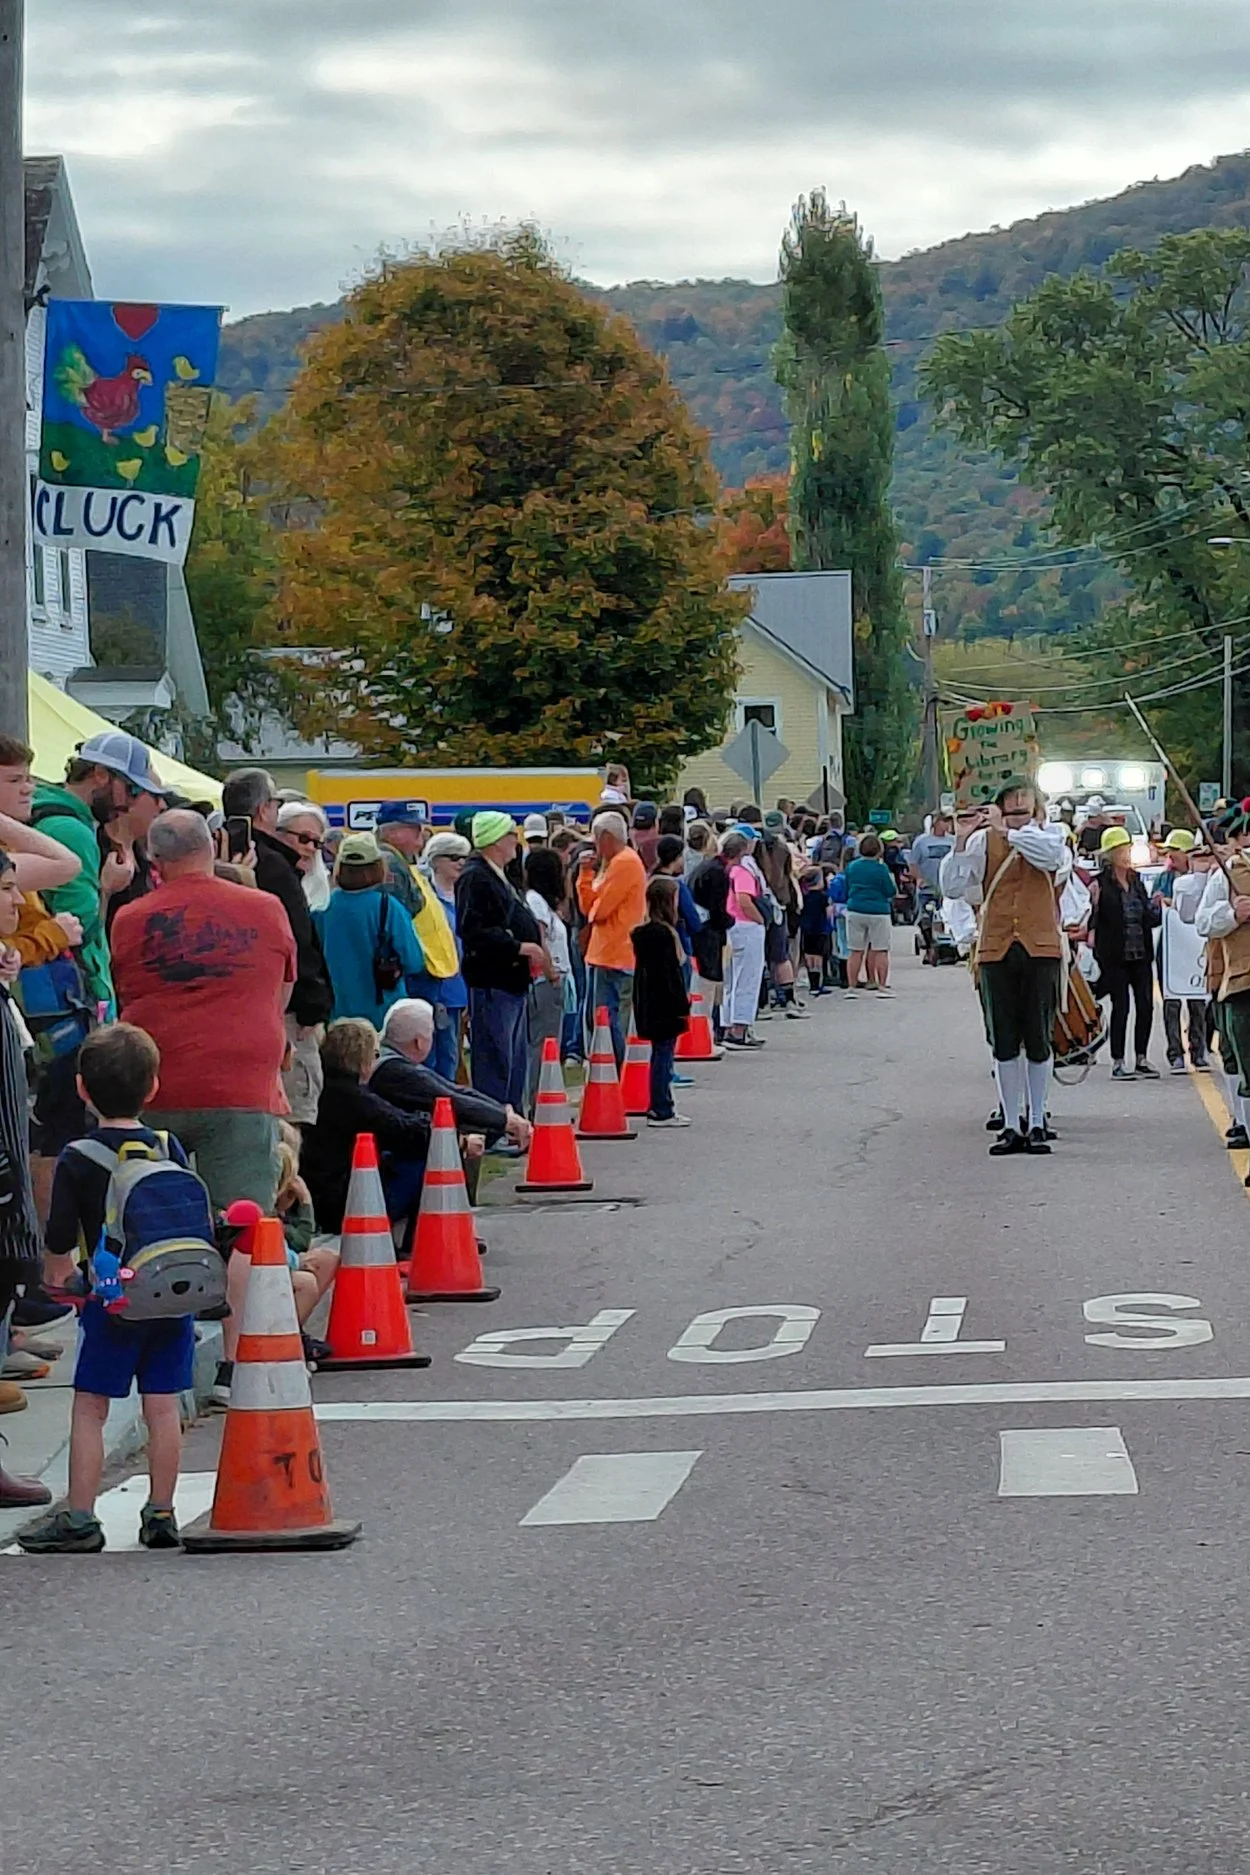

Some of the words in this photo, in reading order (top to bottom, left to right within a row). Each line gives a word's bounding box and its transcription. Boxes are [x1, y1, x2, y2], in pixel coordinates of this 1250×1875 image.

[36, 487, 182, 547] CLUCK
[953, 717, 1024, 740] Growing
[965, 749, 1028, 769] Library
[453, 1292, 1216, 1370] STOP
